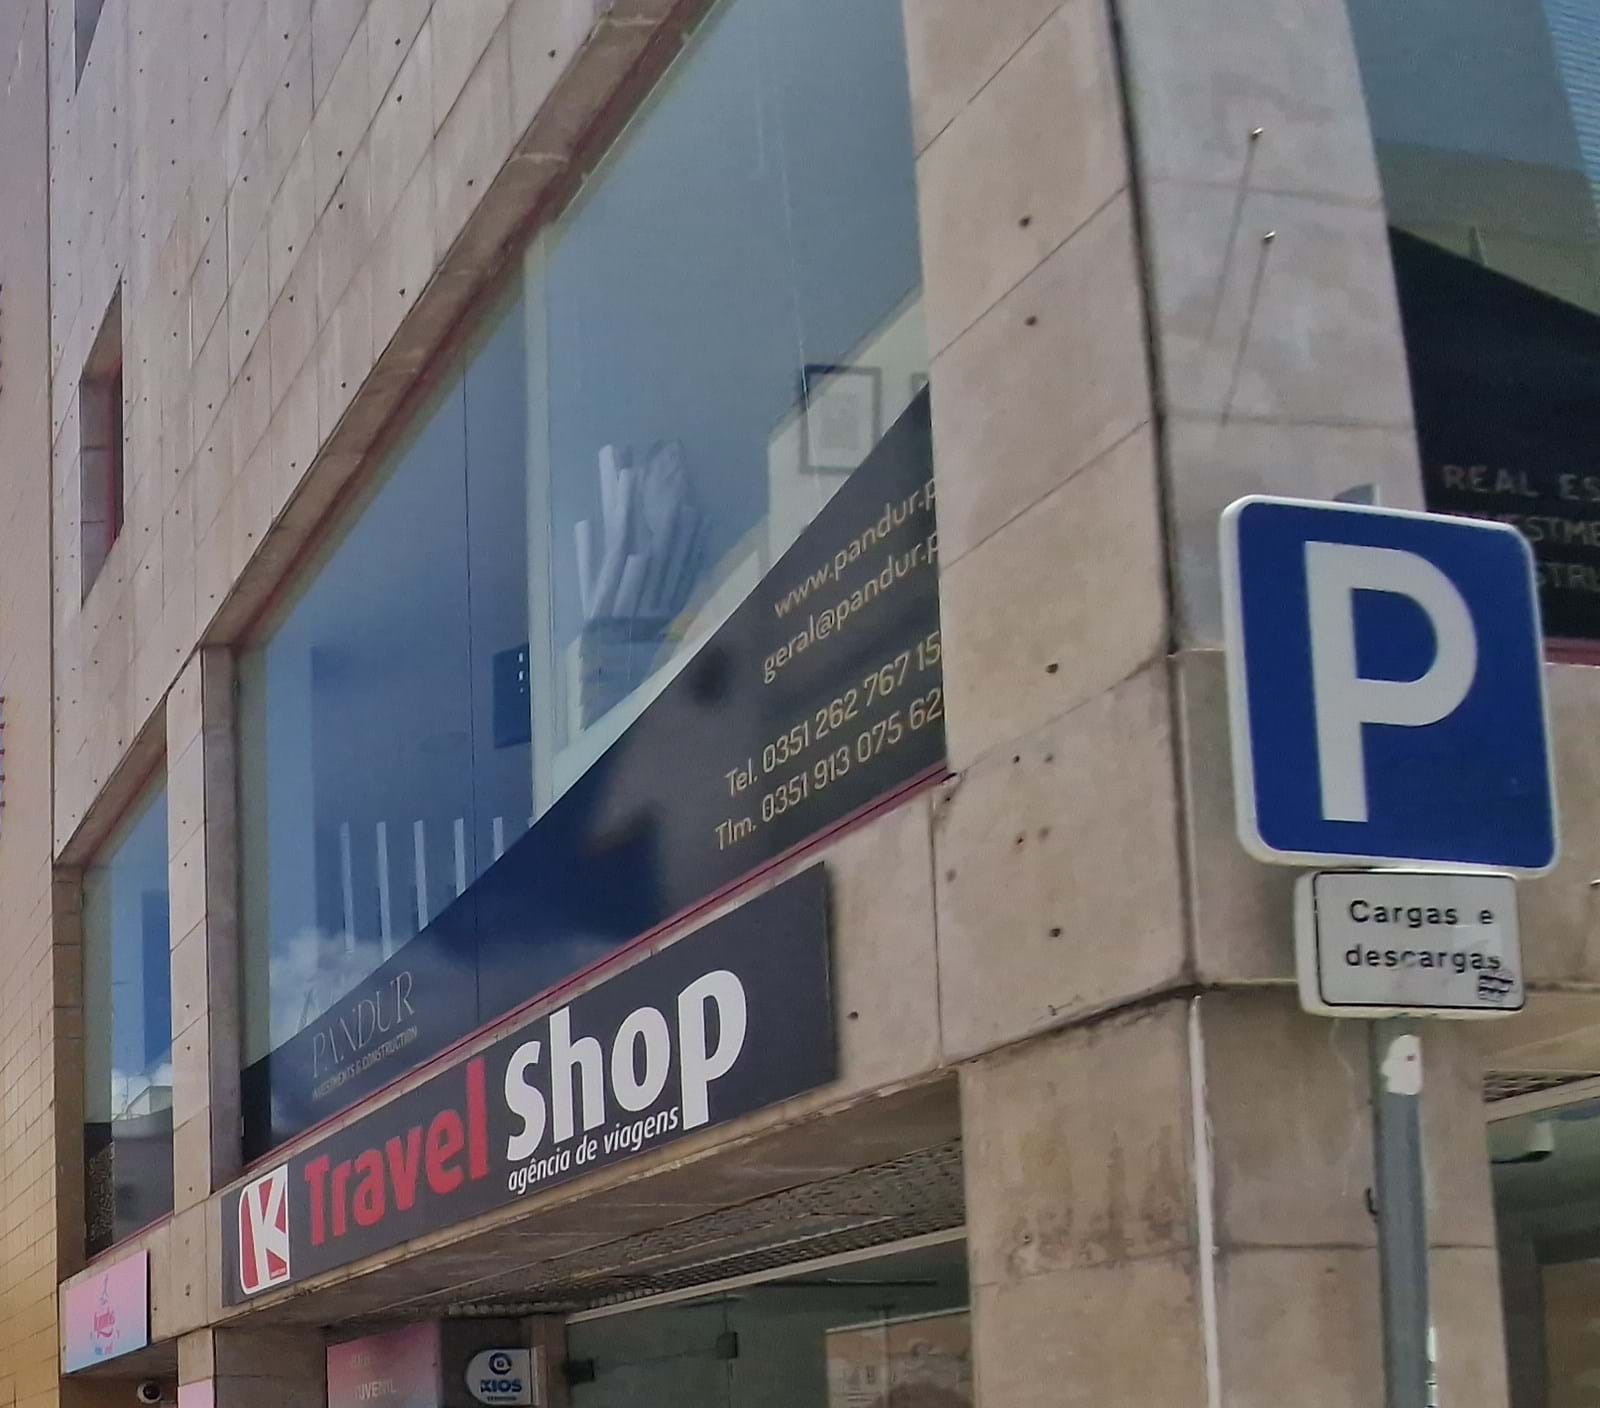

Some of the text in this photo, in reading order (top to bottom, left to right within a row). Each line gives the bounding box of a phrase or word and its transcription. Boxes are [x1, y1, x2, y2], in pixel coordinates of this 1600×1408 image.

[724, 757, 758, 797] Tel.
[762, 720, 809, 774] 0351
[815, 688, 858, 740] 262
[863, 651, 909, 707] 767
[1304, 540, 1478, 824] P
[761, 771, 808, 823] 0351
[813, 744, 850, 791] 913
[857, 710, 902, 763] 075
[1345, 943, 1501, 974] descargas
[1349, 899, 1494, 928] Cargas e
[304, 1055, 489, 1248] Travel
[504, 968, 747, 1162] Shop
[508, 1105, 679, 1197] agência de viagens
